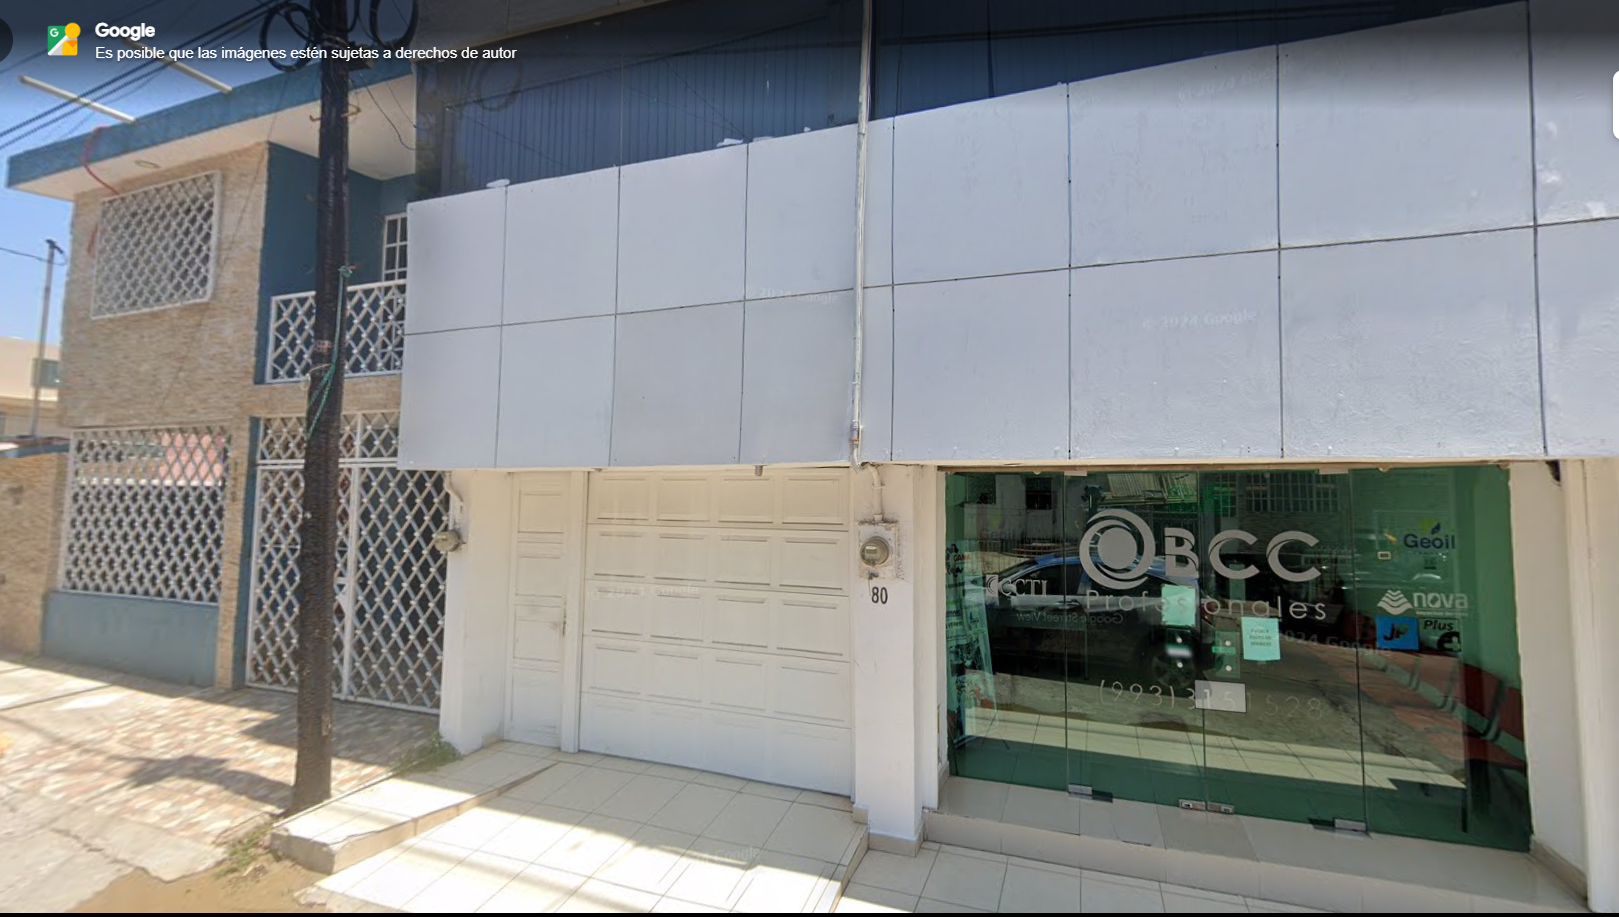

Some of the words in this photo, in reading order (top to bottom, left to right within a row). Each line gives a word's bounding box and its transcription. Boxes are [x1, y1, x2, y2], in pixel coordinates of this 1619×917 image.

[1403, 533, 1455, 549] Geoil
[1165, 527, 1322, 583] BCC
[871, 586, 889, 605] 80
[1000, 577, 1048, 598] CCTI
[1086, 589, 1327, 621] Profesonales
[1413, 592, 1469, 609] nova
[1423, 619, 1454, 631] Plus
